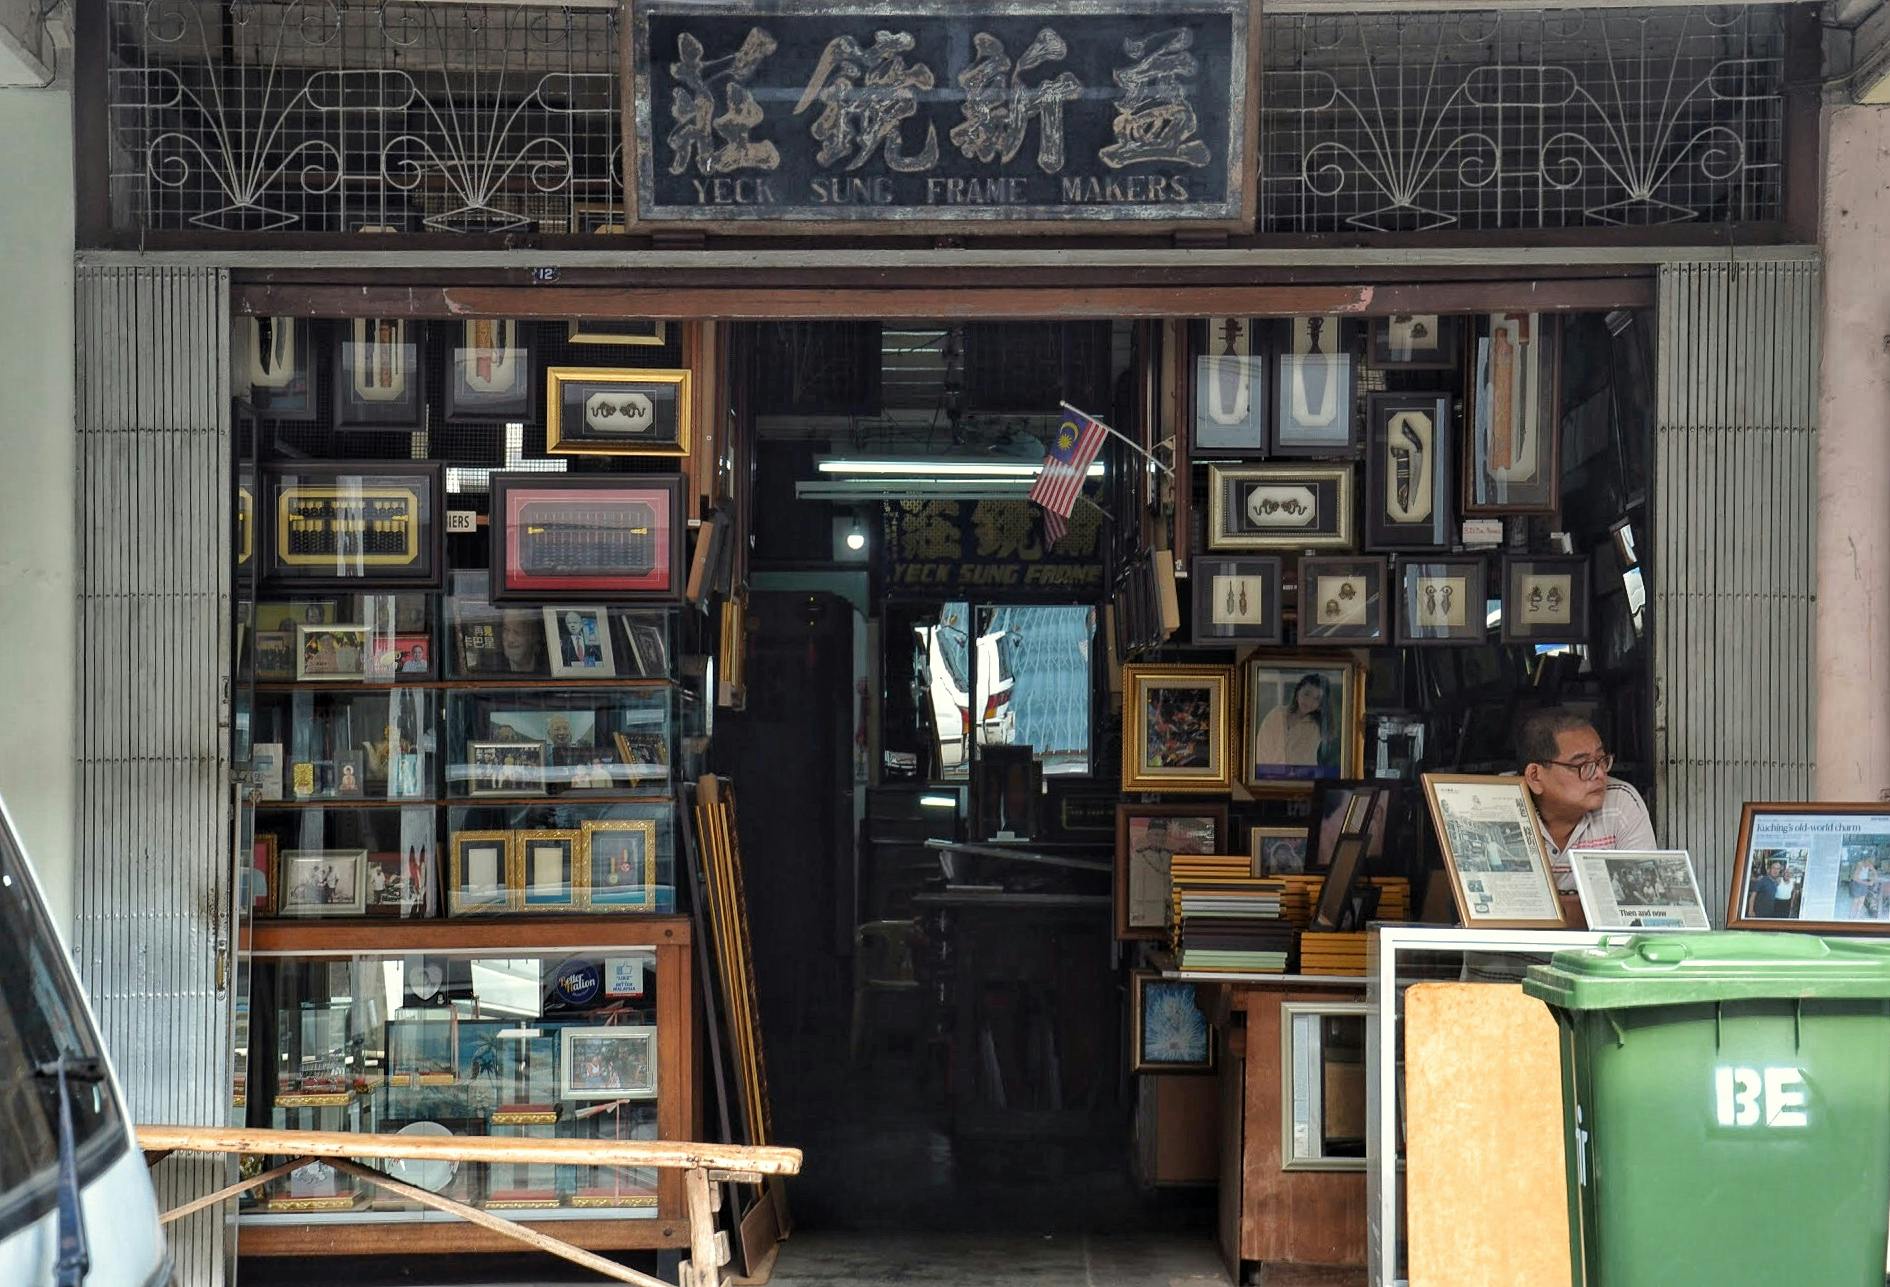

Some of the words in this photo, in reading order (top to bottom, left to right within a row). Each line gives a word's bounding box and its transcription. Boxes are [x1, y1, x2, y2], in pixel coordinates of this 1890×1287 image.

[692, 177, 774, 203] YECK
[810, 177, 894, 203] SUNG
[927, 177, 1028, 203] FRAME
[1061, 175, 1190, 202] MAKERS
[540, 268, 553, 280] 12
[893, 563, 952, 584] YECK
[957, 563, 1021, 584] SUNG
[1757, 823, 1793, 833] Kuching's
[1795, 823, 1833, 832] old-world
[1834, 823, 1861, 832] charm
[1619, 909, 1637, 917] Then
[1715, 1067, 1808, 1126] BE
